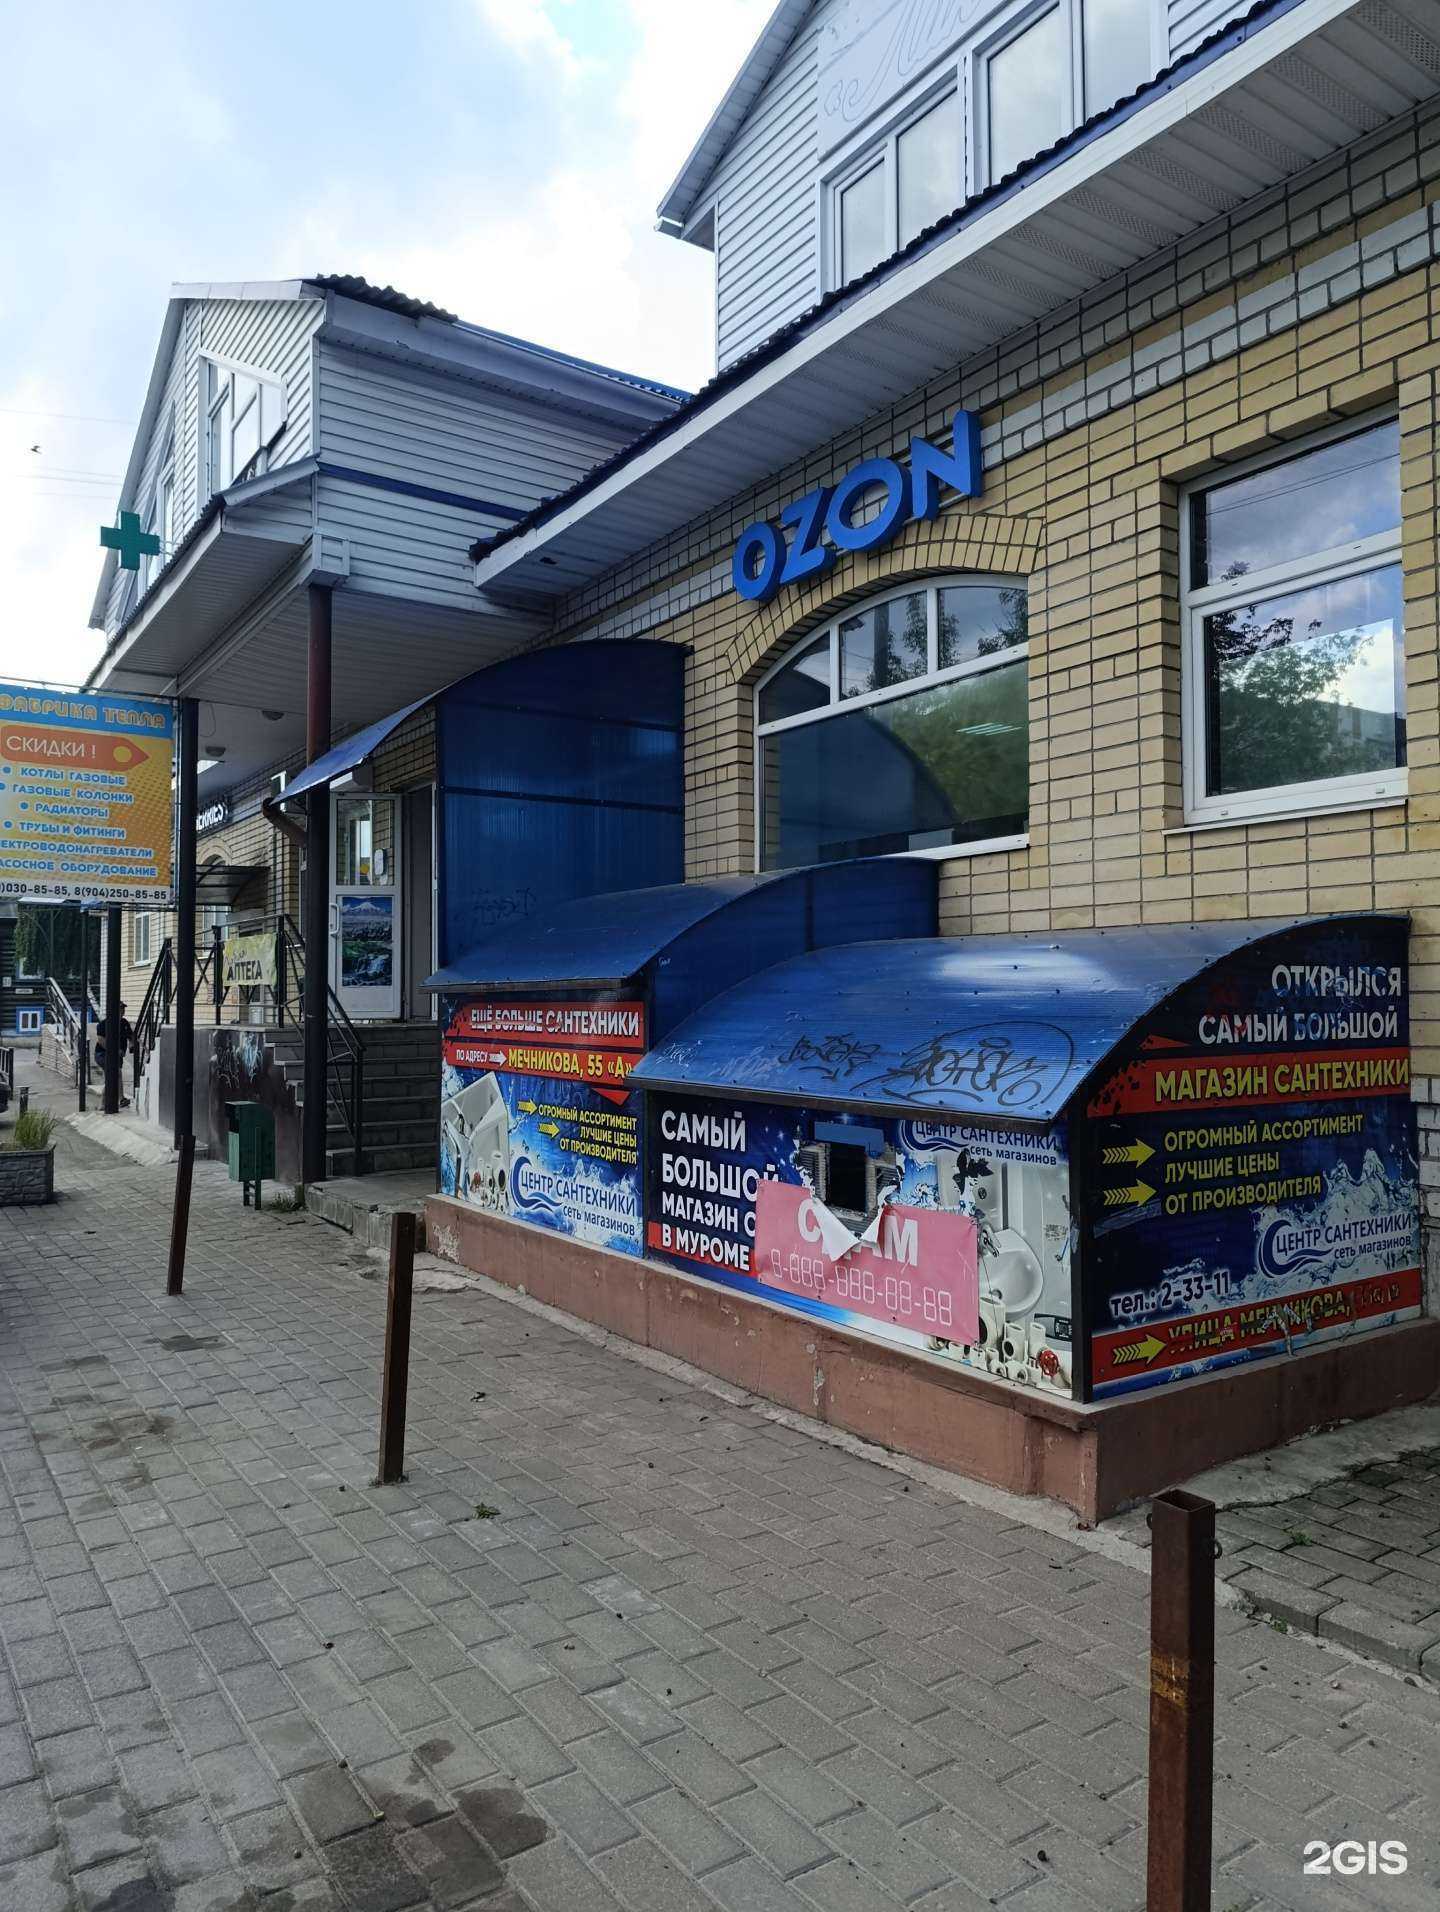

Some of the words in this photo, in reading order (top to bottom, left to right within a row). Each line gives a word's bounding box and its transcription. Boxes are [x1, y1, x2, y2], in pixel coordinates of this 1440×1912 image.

[733, 410, 982, 600] OZON
[103, 707, 166, 728] ТЕПЛА
[7, 736, 84, 758] СКИДКИ
[21, 767, 64, 780] КОТЛЫ
[70, 770, 126, 785] ГАЗОВЫЕ
[13, 784, 70, 798] ГАЗОВЫЕ
[77, 789, 133, 803] КОЛОНКИ
[35, 804, 108, 818] РАДИАТОРЫ
[20, 822, 59, 834] ТРУБЫ
[63, 825, 70, 834] И
[74, 825, 125, 839] ФИТИНГИ
[0, 840, 152, 858] ЕКТРОВОДОНАГРЕВАТЕЛИ
[60, 862, 156, 876] ОБОРУДОВАНИЕ
[0, 883, 71, 896] )030-85-85,
[74, 886, 167, 900] 8(904)250-85-85
[1272, 965, 1402, 997] ОТКРЫЛСЯ
[472, 1005, 493, 1032] ЕЩЁ
[496, 1010, 543, 1032] БОЛЬШЕ
[546, 1010, 639, 1036] САНТЕХНИКИ
[1199, 1006, 1288, 1045] САМЫЙ
[1294, 1005, 1398, 1041] БОЛЬШОЙ
[456, 1049, 465, 1061] ПО
[466, 1050, 488, 1064] АДРЕСУ
[508, 1048, 584, 1080] МЕЧНИКОВА,
[588, 1054, 603, 1077] 55
[1156, 1066, 1269, 1102] МАГАЗИН
[1274, 1057, 1409, 1094] САНТЕХНИКИ
[538, 1102, 578, 1122] ОГРОМНЫЙ
[579, 1112, 638, 1130] АССОРТИМЕНТ
[662, 1110, 746, 1152] САМЫЙ
[580, 1126, 613, 1142] ЛУЧШИЕ
[614, 1132, 637, 1148] ЦЕНЫ
[960, 1126, 1058, 1151] САНТЕХНИКИ
[1164, 1120, 1257, 1152] ОГРОМНЫЙ
[1262, 1114, 1363, 1141] АССОРТИМЕНТ
[560, 1138, 571, 1150] ОТ
[571, 1140, 637, 1164] ПРОИЗВОДИТЕЛЯ
[970, 1144, 993, 1157] сеть
[996, 1148, 1057, 1166] магазинов
[1164, 1156, 1232, 1184] ЛУЧШИЕ
[1237, 1152, 1279, 1177] ЦЕНЫ
[521, 1169, 554, 1195] ЦЕНТР
[556, 1180, 636, 1218] САНТЕХНИКИ
[1165, 1194, 1188, 1214] ОТ
[1192, 1176, 1322, 1210] ПРОИЗВОДИТЕЛЯ
[563, 1205, 582, 1220] сеть
[584, 1213, 636, 1236] магазинов
[662, 1191, 738, 1232] МАГАЗИН
[662, 1223, 672, 1248] В
[676, 1227, 750, 1272] МУРОМЕ
[798, 1198, 919, 1267] СМ
[1276, 1228, 1320, 1256] ЦЕНТР
[1325, 1214, 1412, 1244] САНТЕХНИКИ
[1334, 1243, 1356, 1260] сеть
[1359, 1235, 1412, 1256] магазинов
[1110, 1284, 1157, 1318] тел.:
[1160, 1271, 1230, 1311] 2-33-11
